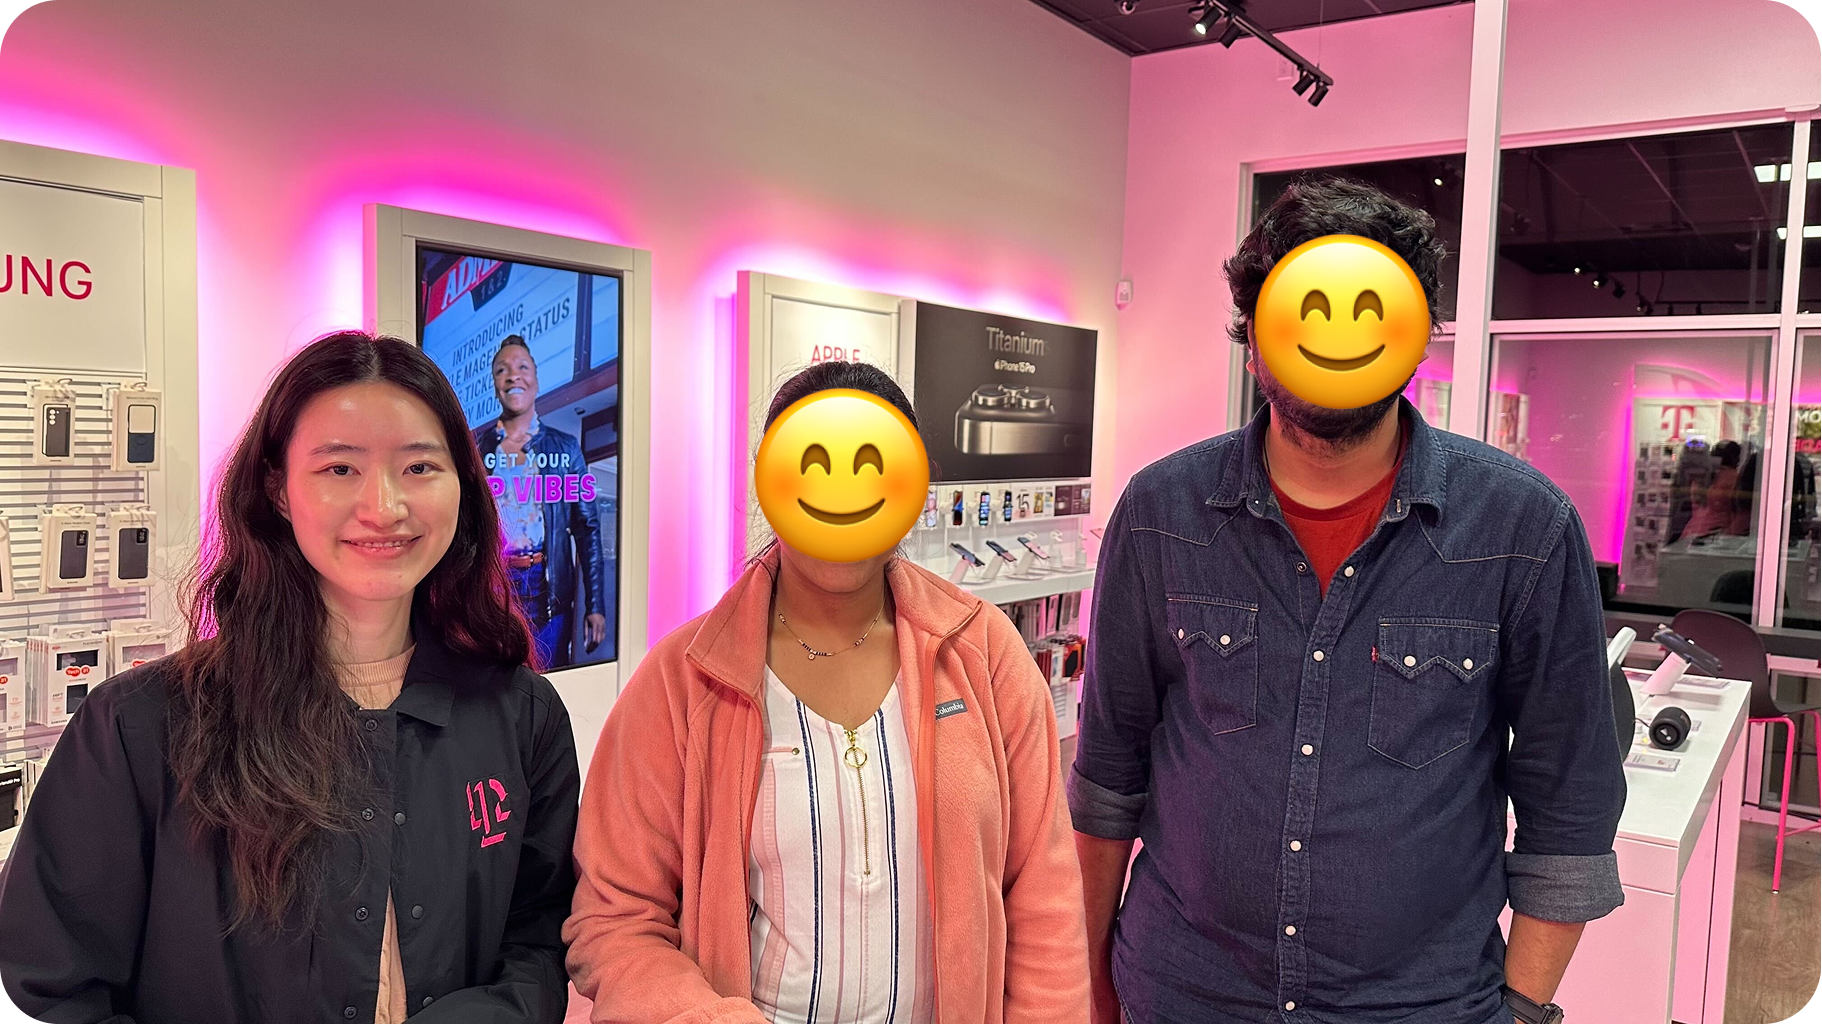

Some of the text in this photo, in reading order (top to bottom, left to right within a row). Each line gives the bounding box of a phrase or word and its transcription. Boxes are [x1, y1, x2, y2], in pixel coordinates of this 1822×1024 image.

[519, 297, 570, 341] STATUS
[452, 303, 524, 368] INTRODUCING
[985, 326, 1045, 357] Titanium
[484, 453, 570, 469] GET YOUR
[513, 472, 597, 503] VIBES
[1016, 493, 1030, 510] 15
